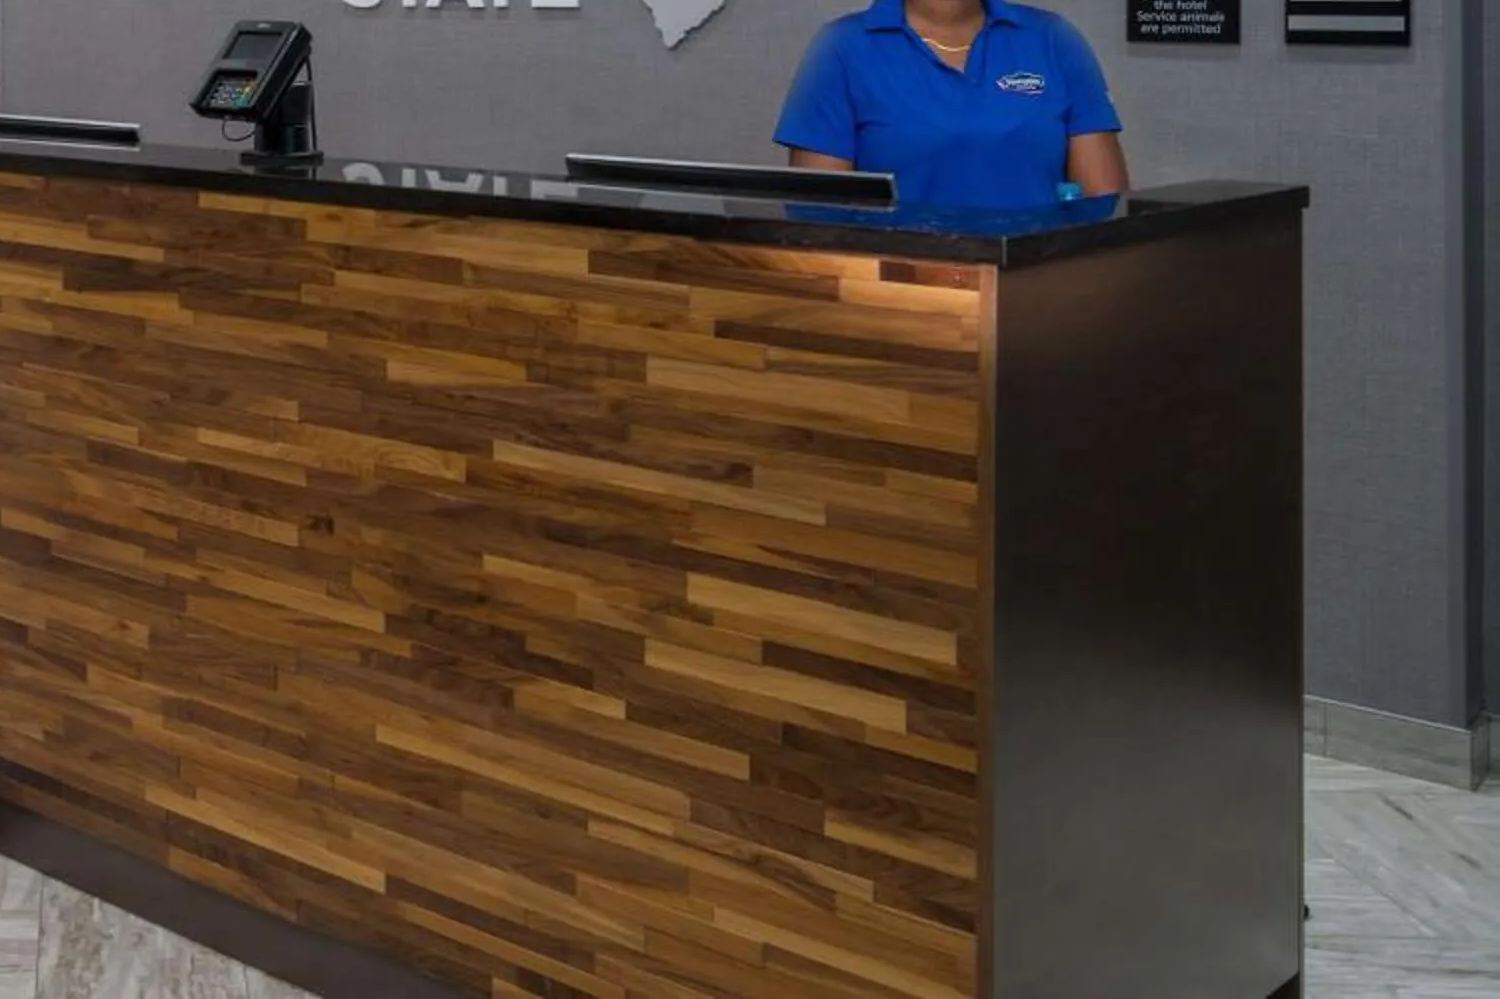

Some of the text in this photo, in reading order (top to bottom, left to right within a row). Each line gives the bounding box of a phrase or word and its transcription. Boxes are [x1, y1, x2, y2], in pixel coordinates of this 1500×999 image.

[1154, 0, 1207, 10] the hotel
[1137, 10, 1225, 22] Service animals
[1141, 24, 1221, 35] are permitted
